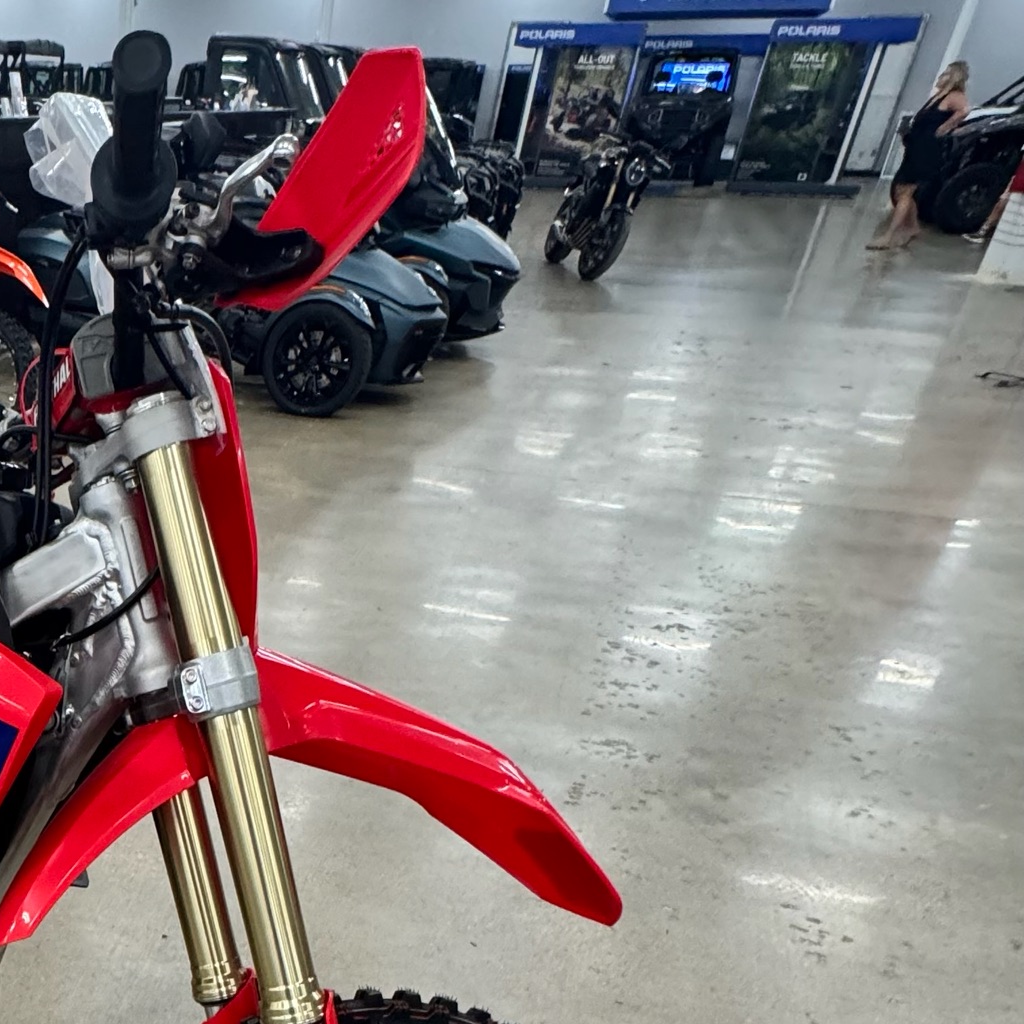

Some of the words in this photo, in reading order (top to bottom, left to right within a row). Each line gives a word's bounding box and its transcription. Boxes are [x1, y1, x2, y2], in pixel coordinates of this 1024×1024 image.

[519, 28, 576, 40] POLARIS
[777, 25, 841, 36] POLARIS
[644, 39, 694, 49] POLARIS
[577, 54, 616, 65] ALL-OUT
[672, 64, 726, 75] POLARIS
